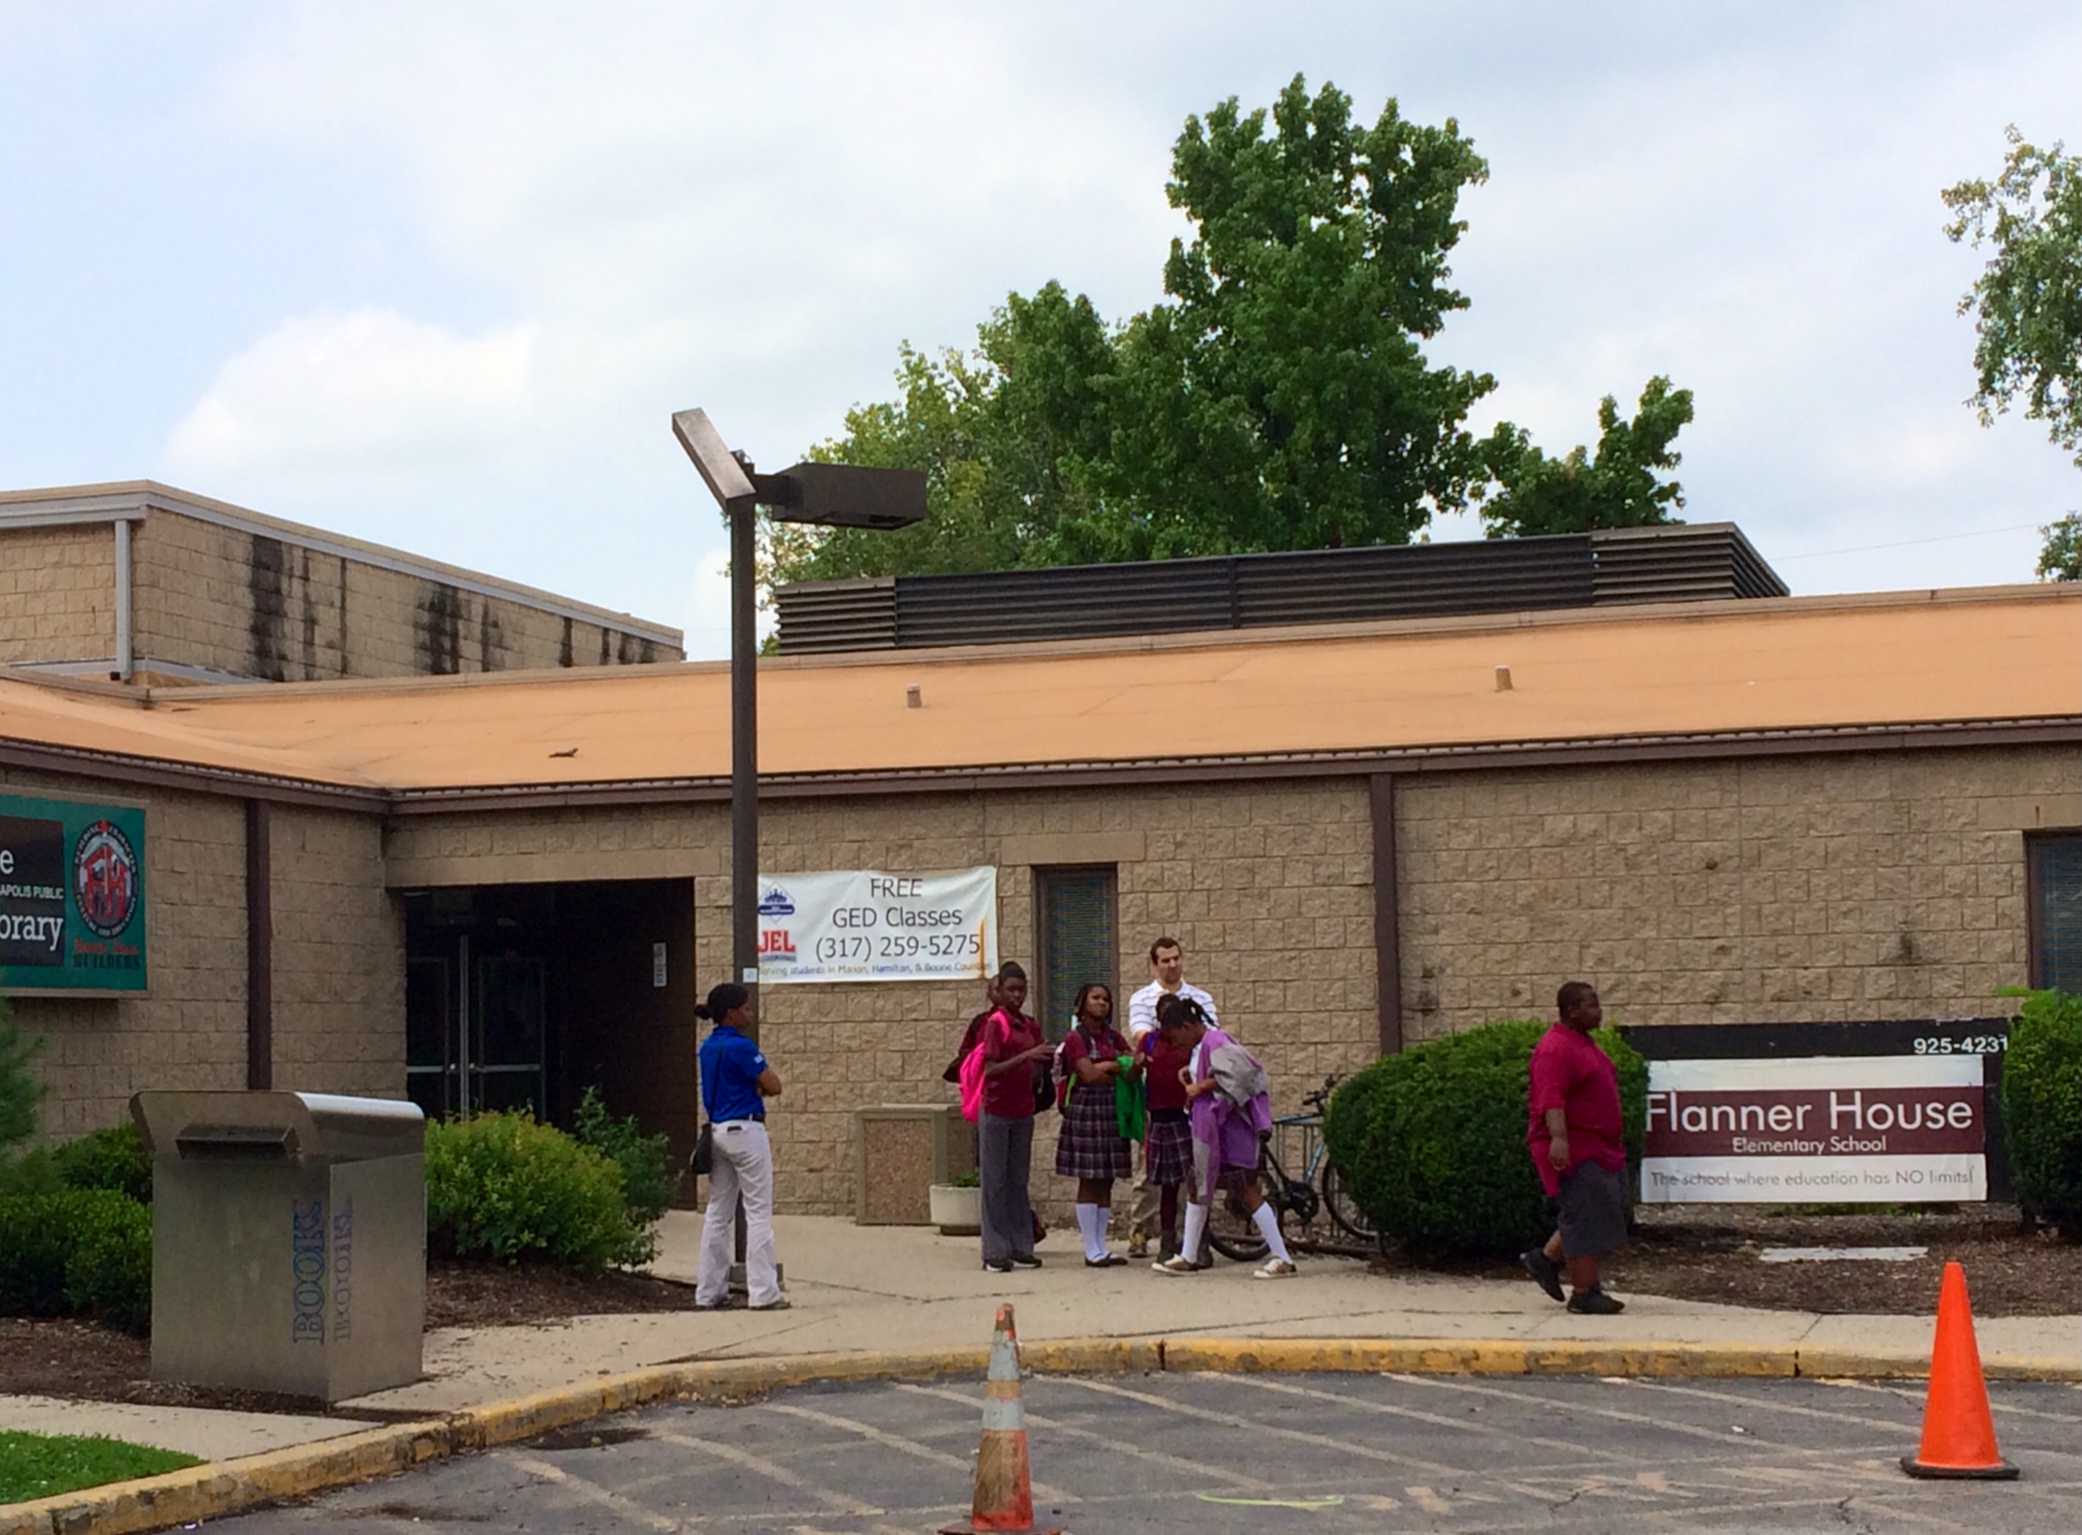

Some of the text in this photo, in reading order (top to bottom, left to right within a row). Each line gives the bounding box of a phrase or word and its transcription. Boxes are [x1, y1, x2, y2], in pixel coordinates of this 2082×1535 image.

[33, 886, 64, 899] PUBLIC
[870, 878, 924, 898] FREE
[832, 906, 963, 928] GED Classes
[756, 930, 797, 953] JEL
[815, 933, 980, 963] (317) 259-5275
[758, 964, 788, 977] erving
[1913, 1036, 2008, 1055] 925-4231
[1646, 1090, 1974, 1132] Flanner House
[1732, 1134, 1888, 1155] Elementary School
[1650, 1171, 1679, 1187] The
[1682, 1171, 1730, 1187] school
[1734, 1171, 1780, 1186] where
[1785, 1170, 1859, 1186] education
[1864, 1170, 1891, 1185] has
[1896, 1169, 1925, 1184] NO
